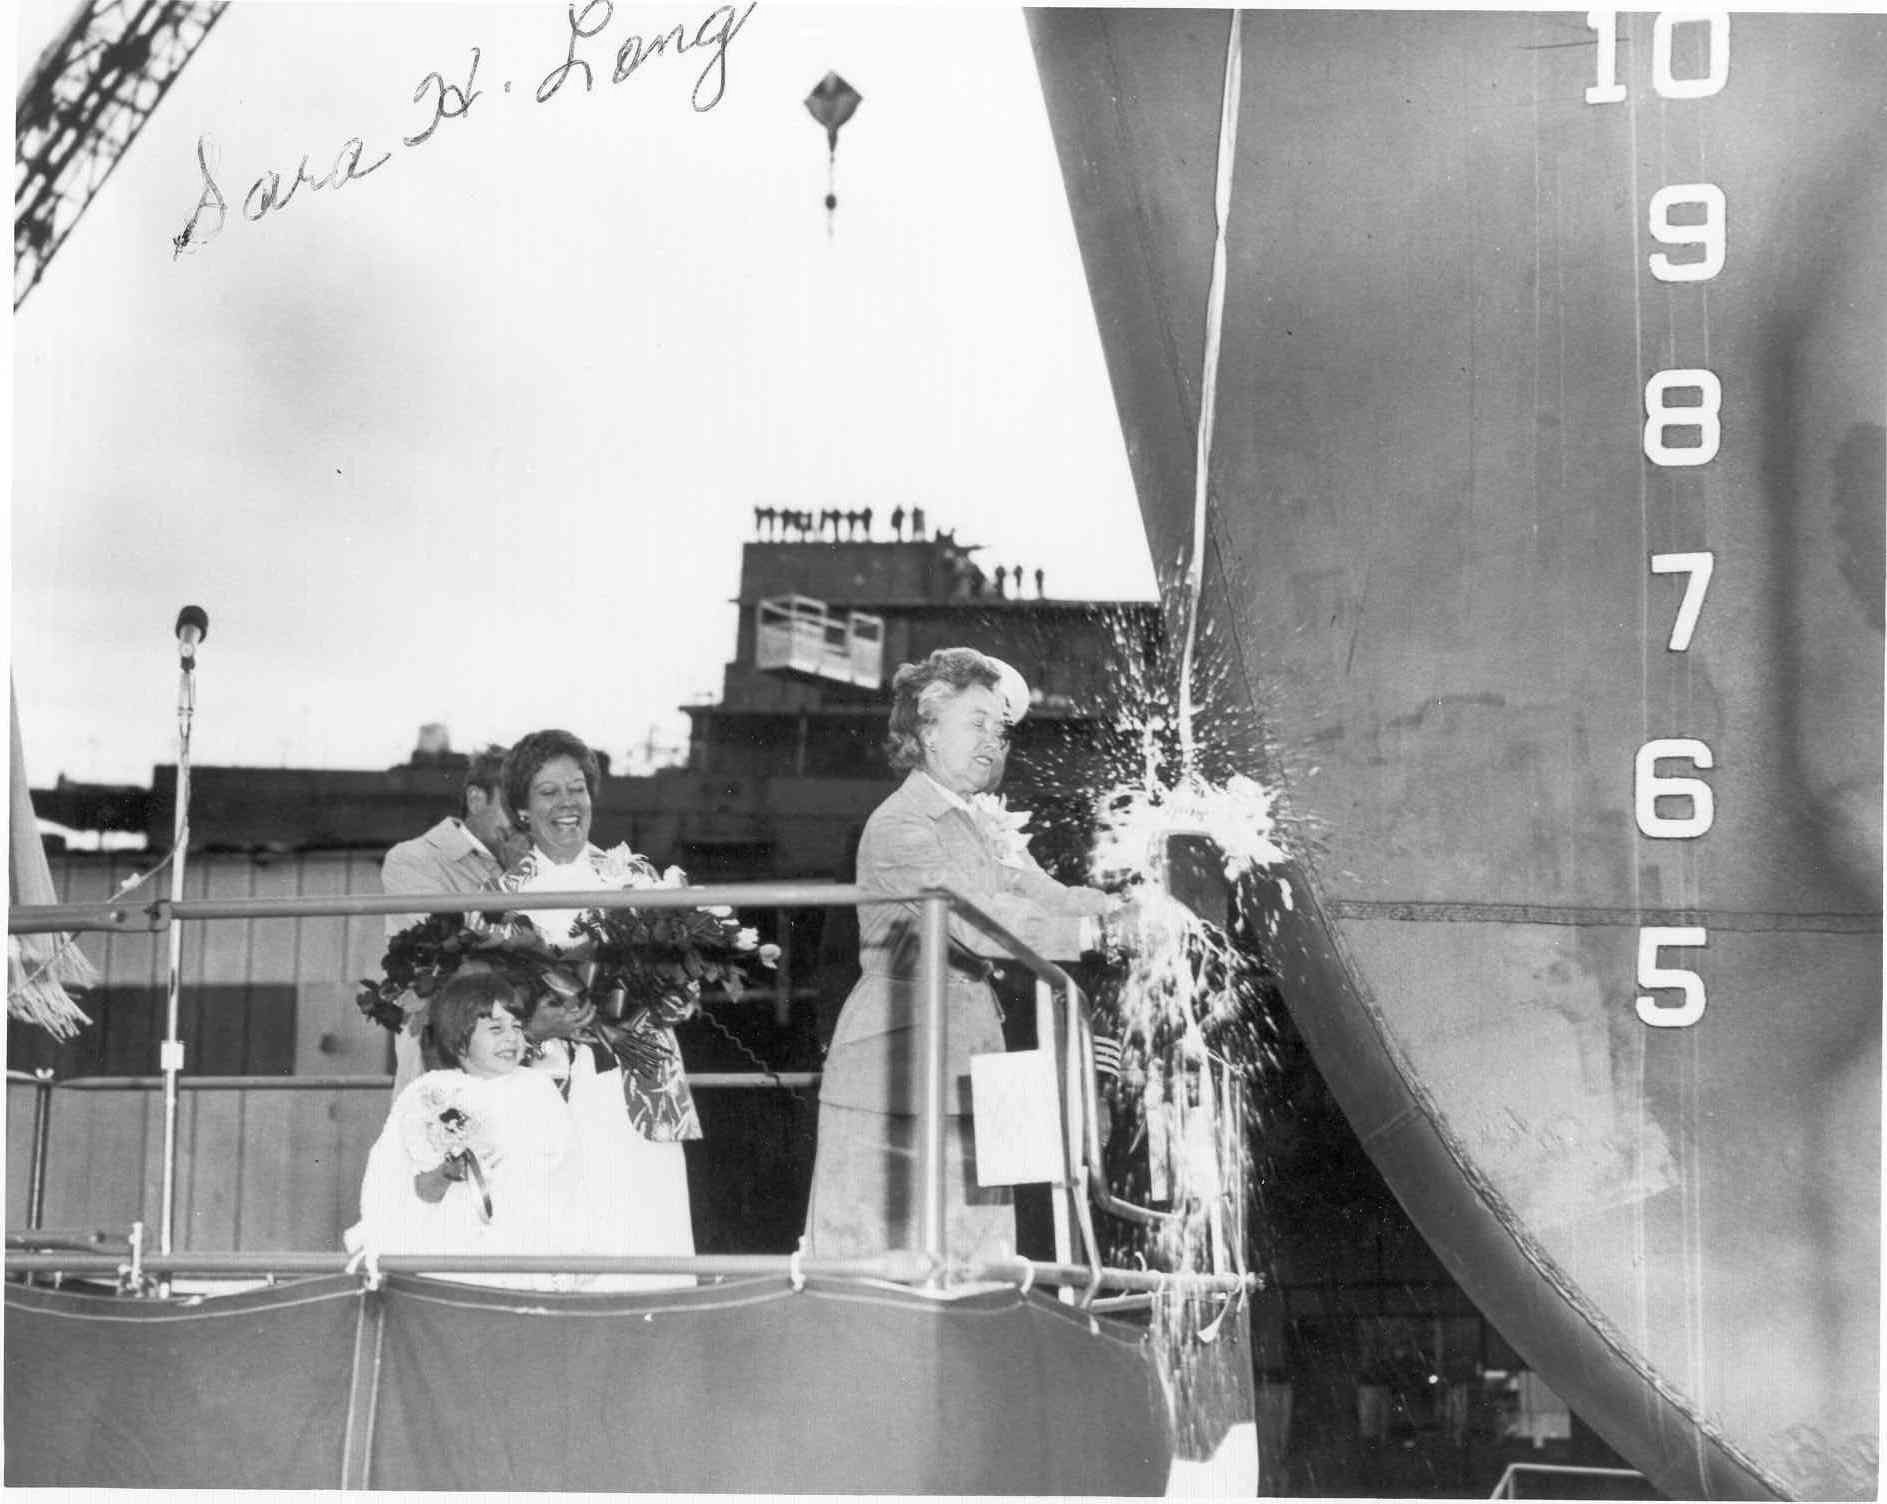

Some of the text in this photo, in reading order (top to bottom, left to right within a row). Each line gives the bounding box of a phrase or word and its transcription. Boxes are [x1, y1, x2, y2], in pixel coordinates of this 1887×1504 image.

[1585, 10, 1730, 104] 10
[172, 133, 391, 261] Sara
[536, 0, 756, 112] Long
[1648, 183, 1726, 282] 9
[1643, 369, 1722, 467] 8
[1651, 552, 1714, 652] 7
[1634, 738, 1714, 839] 6
[1635, 926, 1708, 1028] 5
